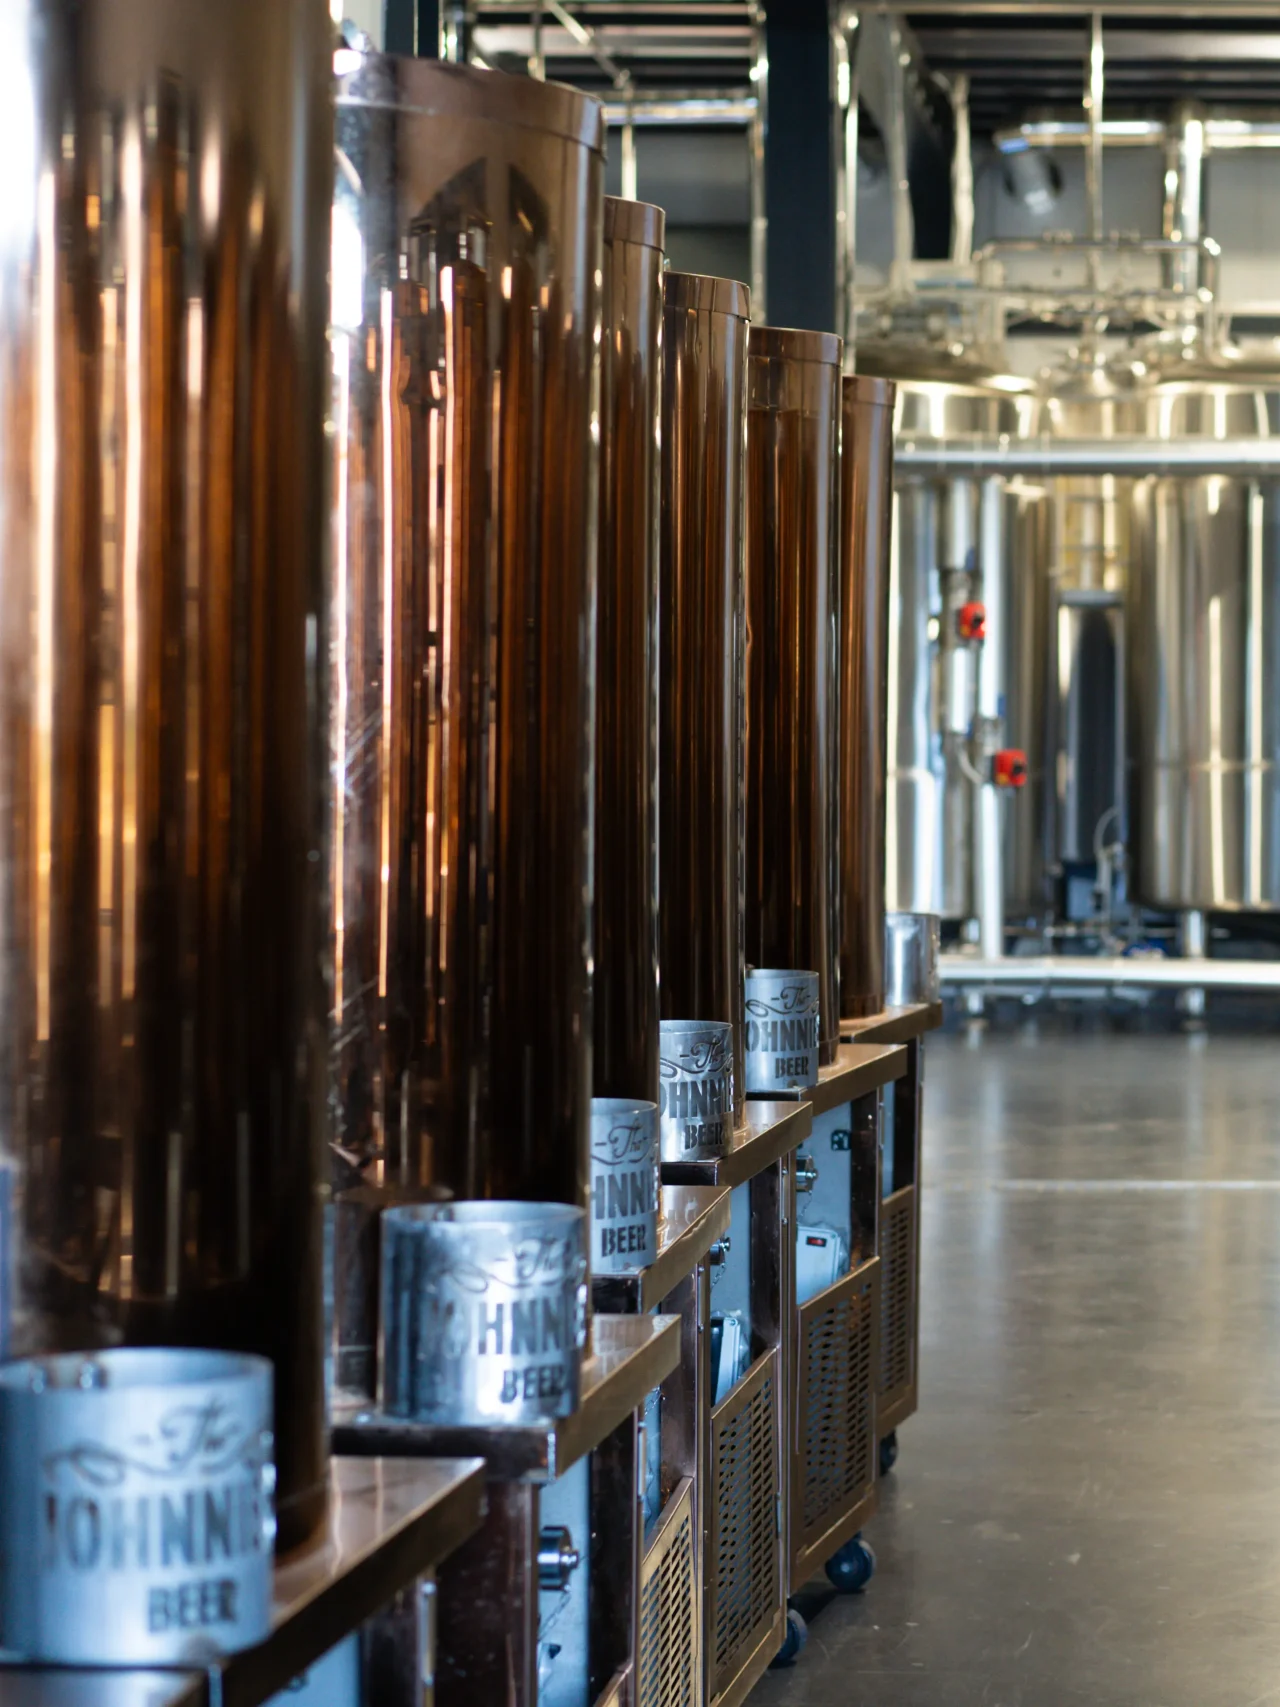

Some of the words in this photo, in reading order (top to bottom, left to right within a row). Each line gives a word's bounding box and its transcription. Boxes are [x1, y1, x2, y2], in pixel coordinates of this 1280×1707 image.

[775, 1056, 808, 1079] BEER
[684, 1122, 723, 1150] BEER
[602, 1223, 646, 1257] BEER
[500, 1363, 566, 1404] BEER
[147, 1578, 238, 1634] BEER
